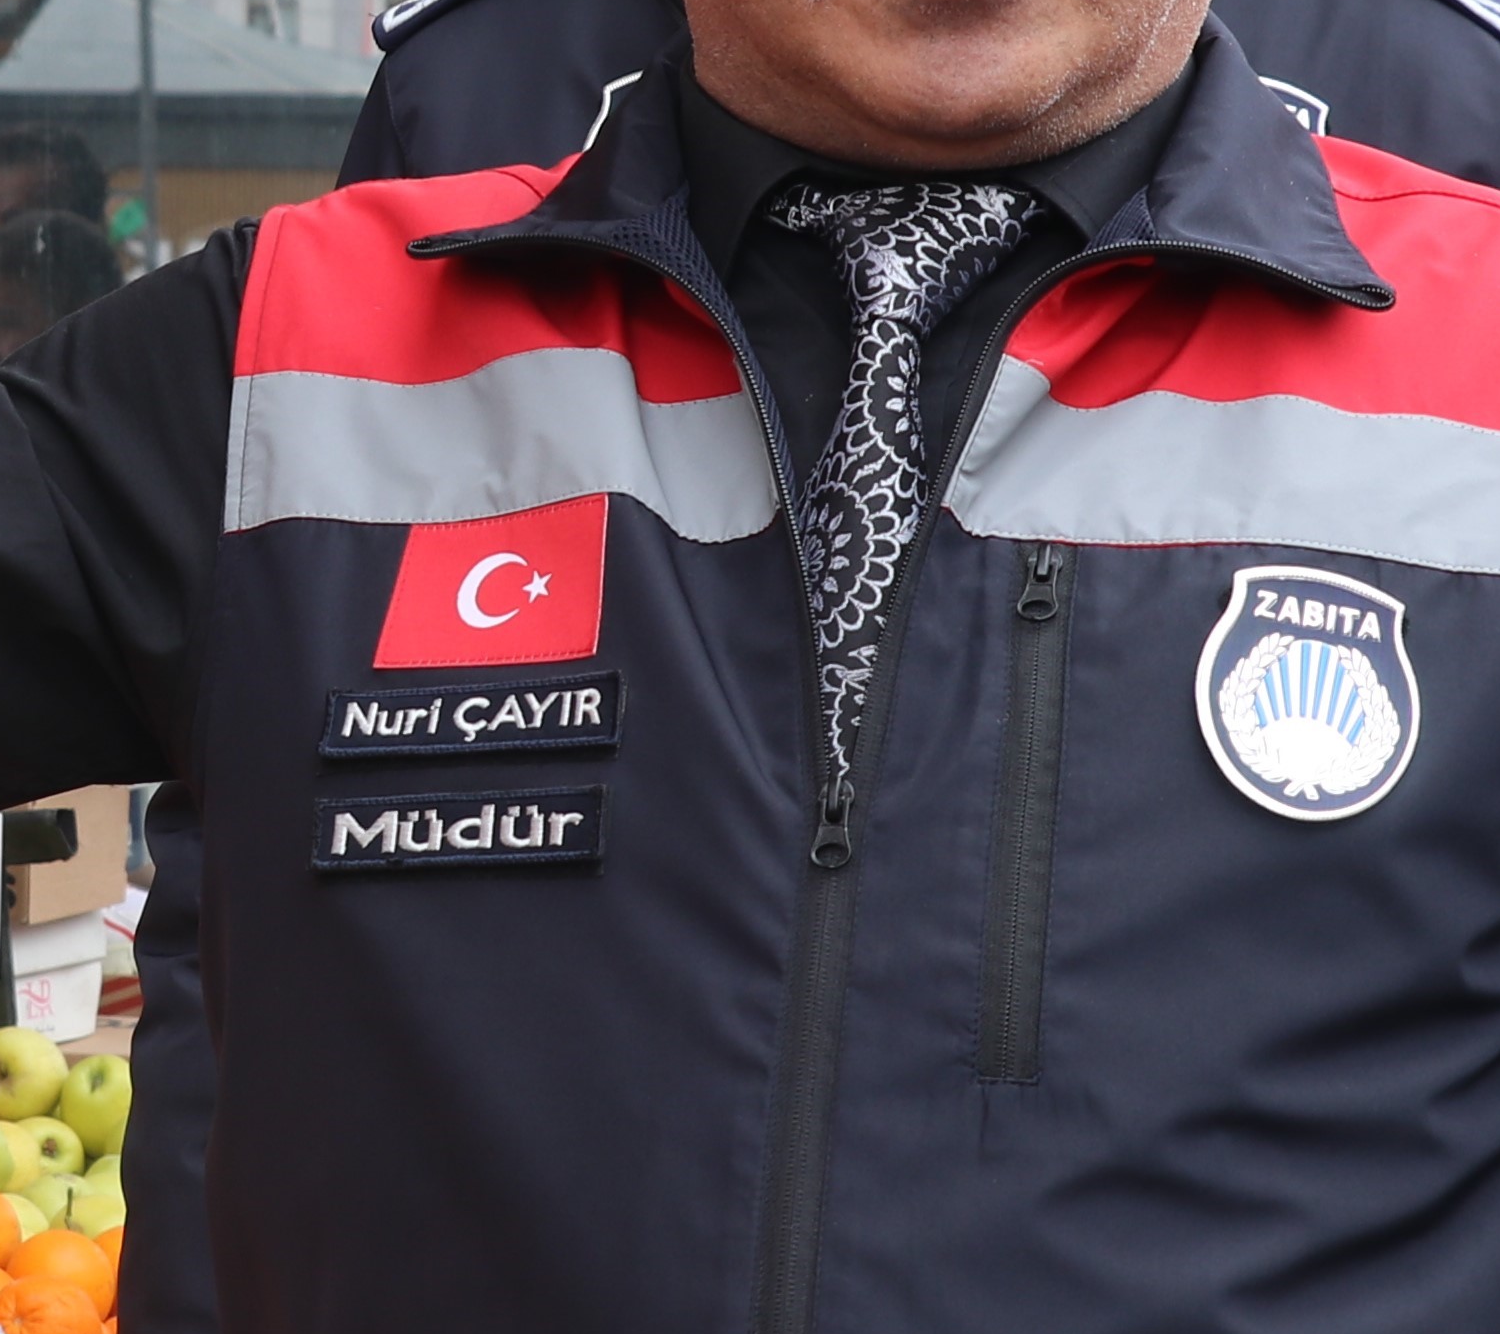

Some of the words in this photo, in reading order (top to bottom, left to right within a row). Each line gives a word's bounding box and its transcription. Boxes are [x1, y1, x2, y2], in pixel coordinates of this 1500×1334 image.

[1253, 589, 1382, 643] ZABITA
[340, 697, 443, 738] Nuri
[452, 687, 602, 743] ÇAYIR
[330, 803, 585, 856] Müdür
